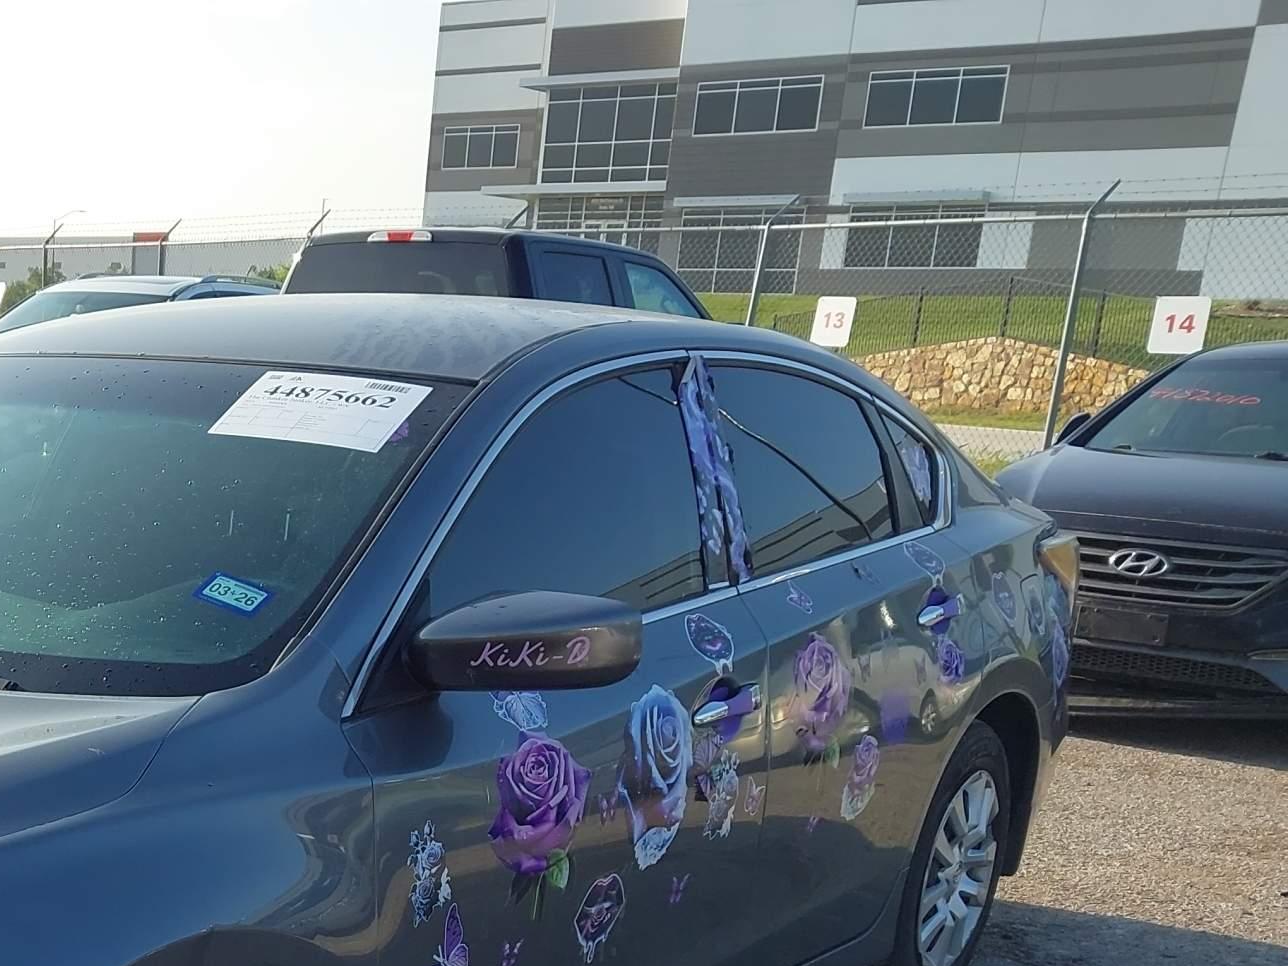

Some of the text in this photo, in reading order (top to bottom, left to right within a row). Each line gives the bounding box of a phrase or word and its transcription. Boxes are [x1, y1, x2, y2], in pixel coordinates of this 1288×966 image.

[823, 312, 846, 329] 13
[1164, 313, 1196, 334] 14
[263, 385, 398, 409] 44875662
